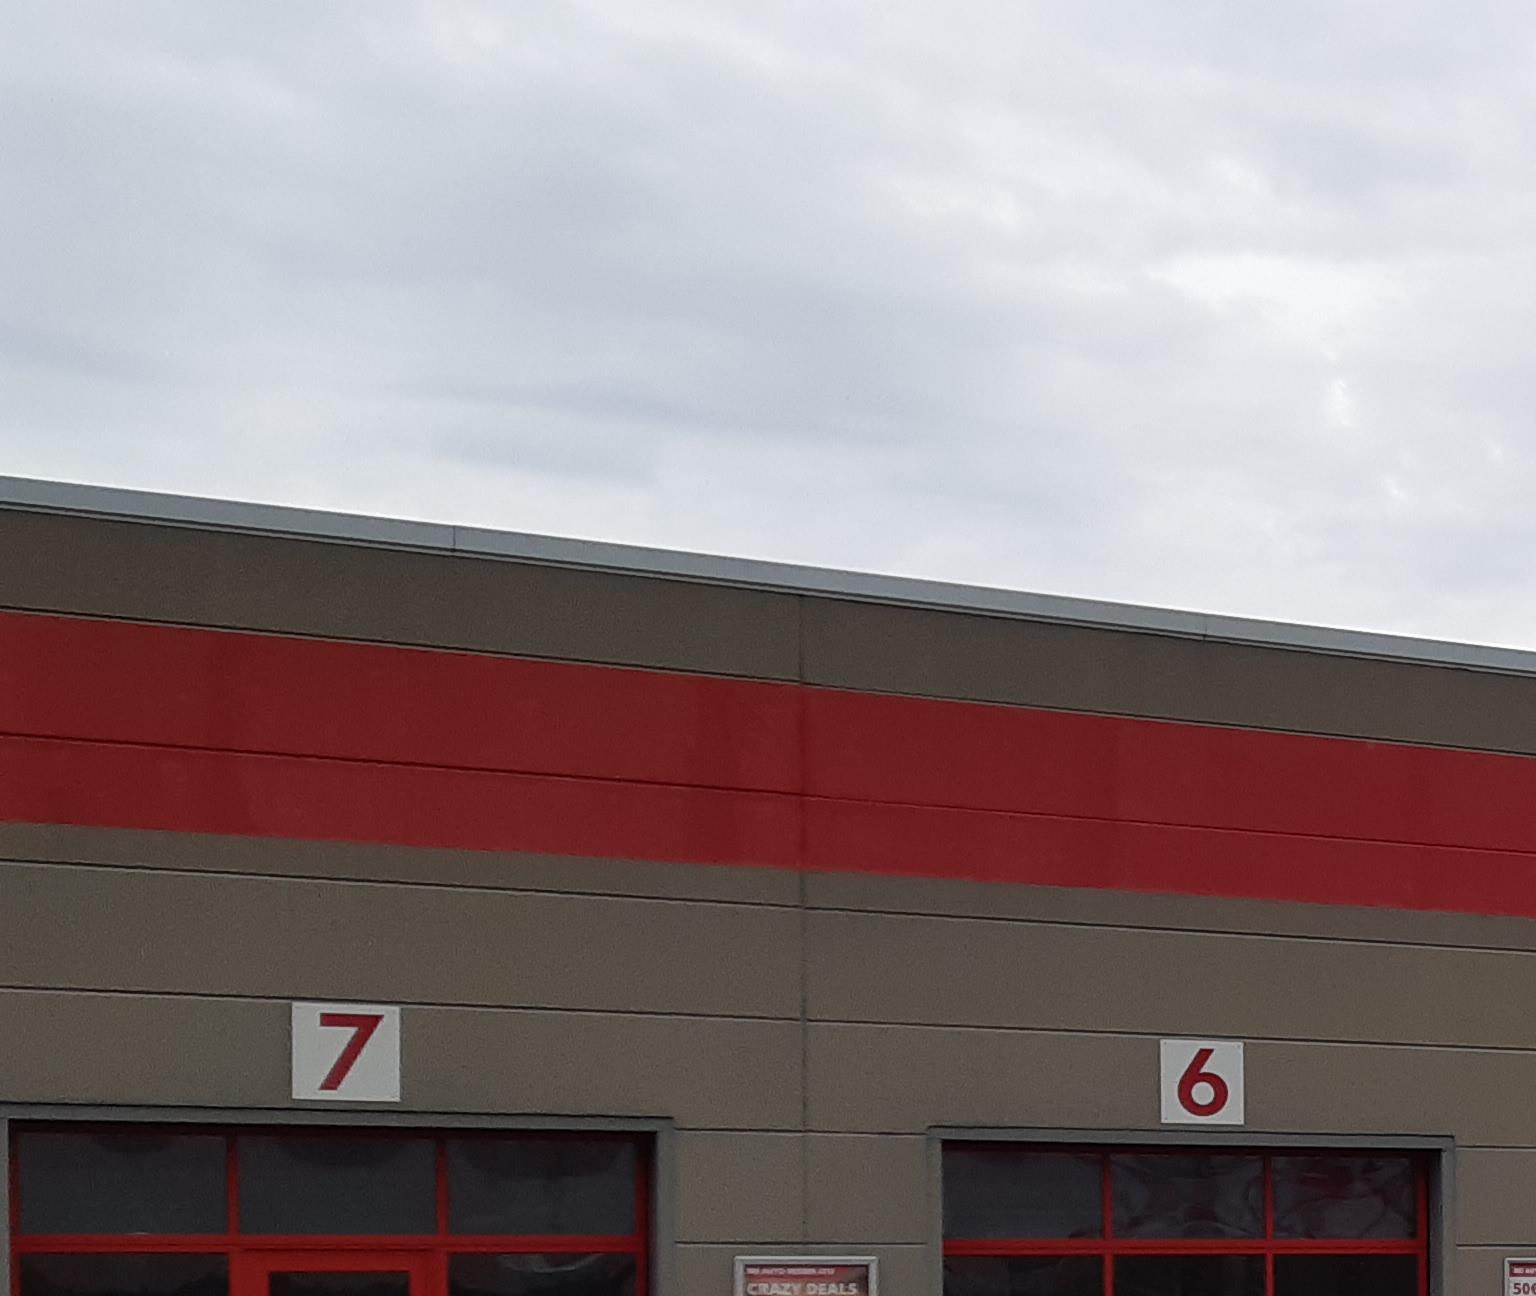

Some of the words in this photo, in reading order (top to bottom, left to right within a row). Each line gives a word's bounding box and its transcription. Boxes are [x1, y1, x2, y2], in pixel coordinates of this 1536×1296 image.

[318, 1012, 384, 1091] 7
[1177, 1048, 1230, 1117] 6
[746, 1282, 801, 1295] CRAZY
[806, 1282, 858, 1295] DEALS
